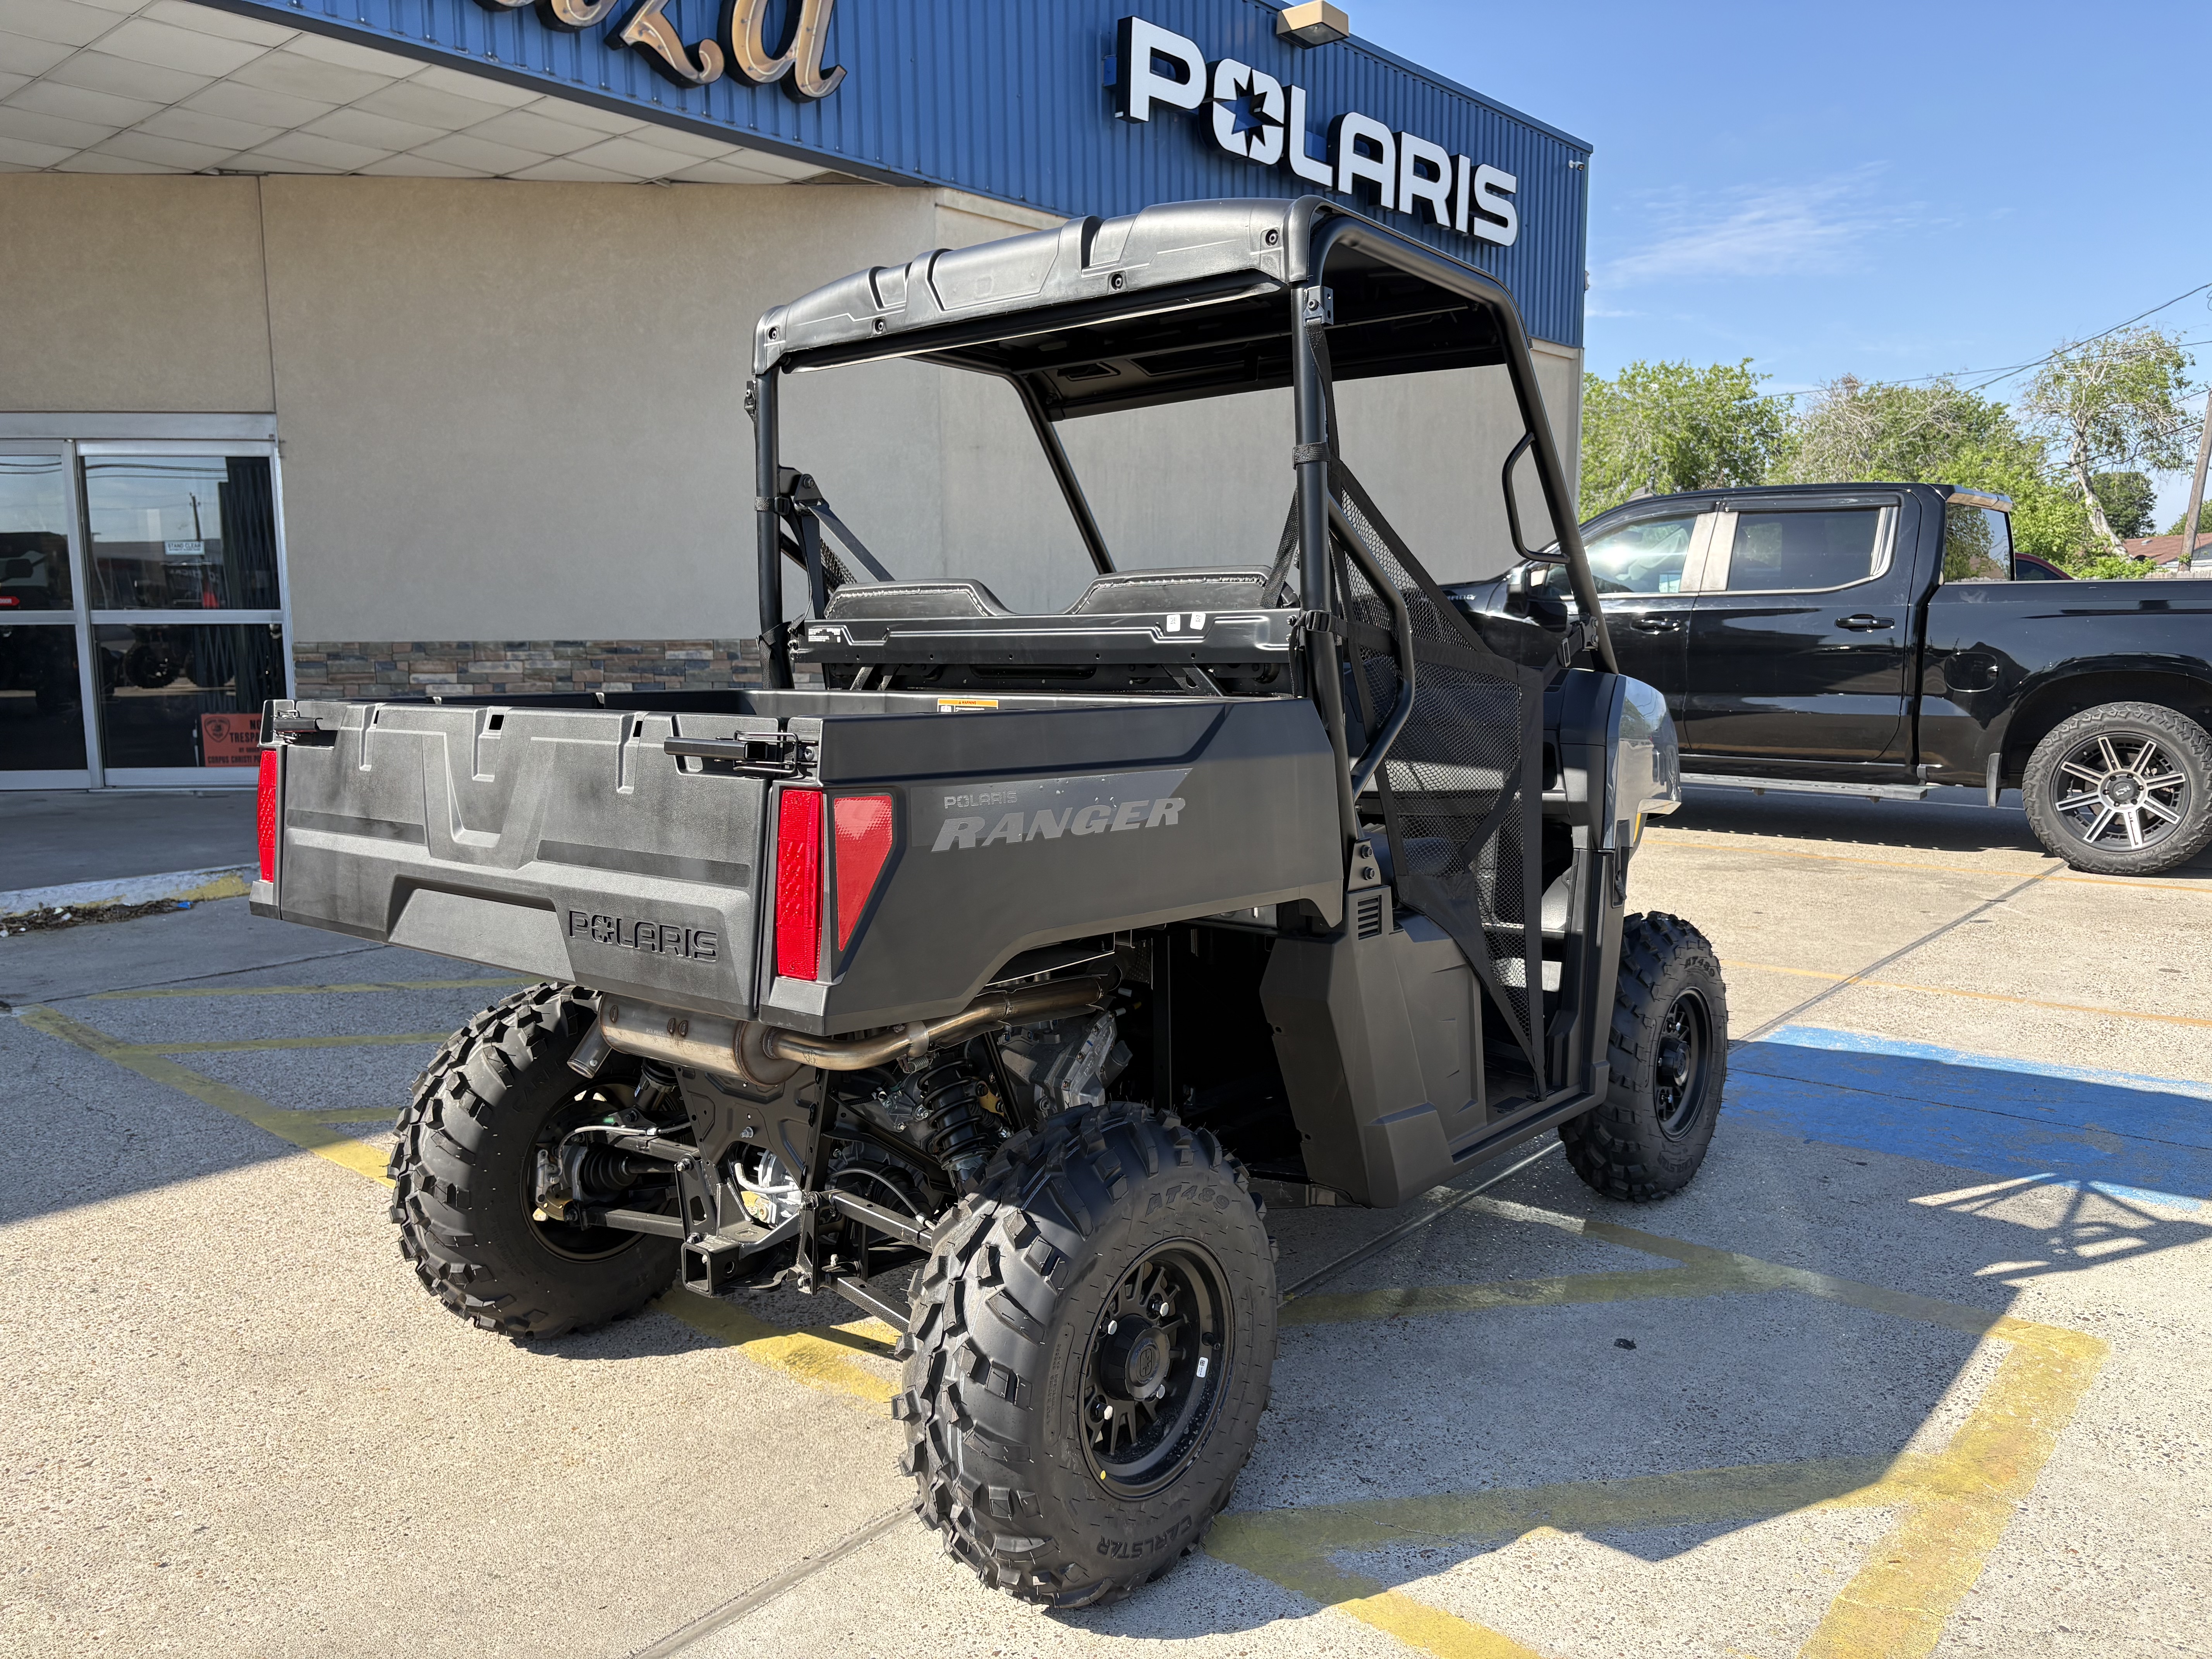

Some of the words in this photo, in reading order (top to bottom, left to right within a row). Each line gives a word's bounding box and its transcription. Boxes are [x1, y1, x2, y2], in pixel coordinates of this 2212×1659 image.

[1129, 15, 1518, 247] POLARIS
[944, 791, 1018, 809] POLARIS
[931, 798, 1185, 852] RANGER
[569, 910, 717, 962] POLARIS
[1145, 1185, 1230, 1218] AT489
[1096, 1514, 1192, 1559] CARLSTAR
